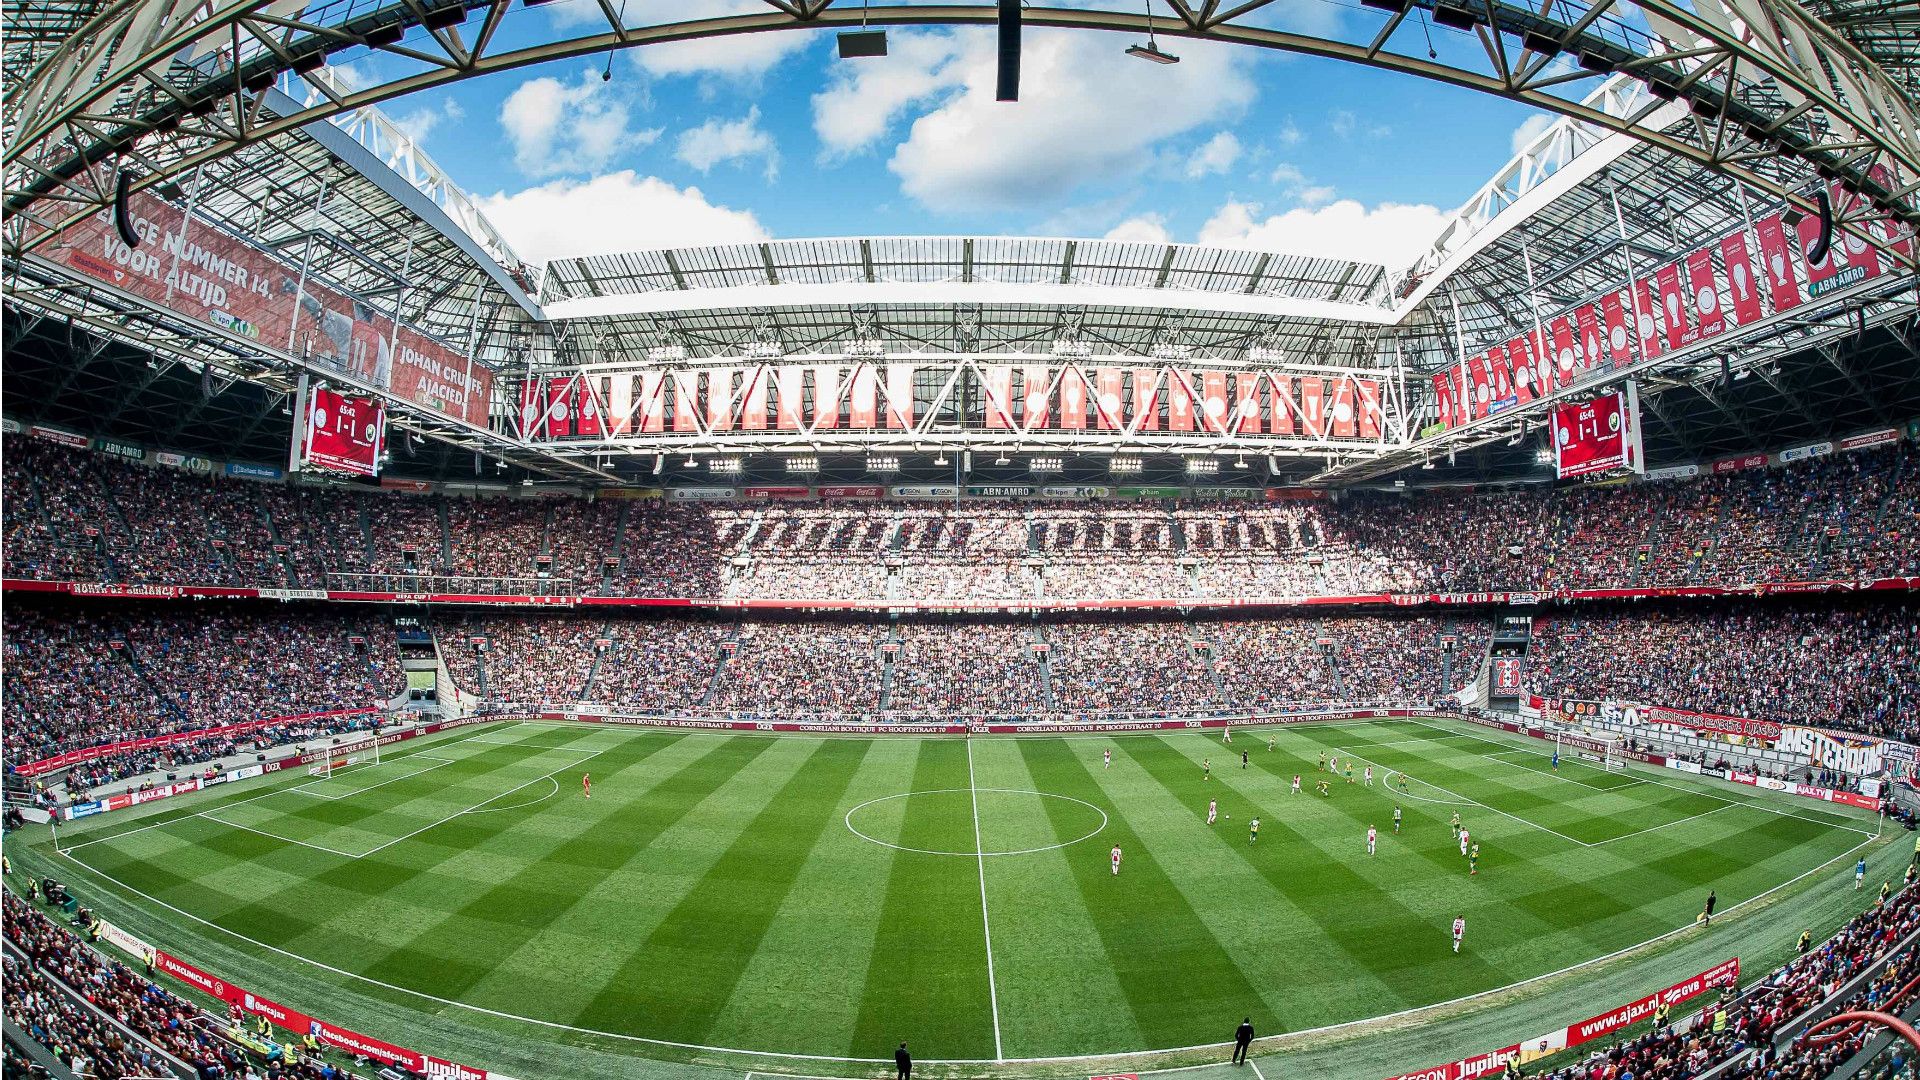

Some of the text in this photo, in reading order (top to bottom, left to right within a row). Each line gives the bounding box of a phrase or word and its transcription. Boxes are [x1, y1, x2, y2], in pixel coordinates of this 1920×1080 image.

[104, 235, 160, 279] VOOR
[163, 231, 247, 288] NUMMER
[252, 275, 273, 300] 14.
[165, 268, 230, 310] ALTIJD.
[219, 314, 230, 326] kpn
[400, 346, 441, 377] JOHAN
[1774, 728, 1883, 776] AMSTERDAM
[139, 787, 166, 802] AJAX.NL
[1797, 785, 1826, 797] AJAX.TV
[166, 960, 212, 988] AJAXCLINICS.NL
[1681, 981, 1700, 996] GVB
[255, 1001, 286, 1020] @afcajax
[1581, 994, 1659, 1037] www.ajax.nl
[322, 1028, 414, 1066] facebook.com/afcajax
[1455, 1049, 1517, 1080] Jupiler
